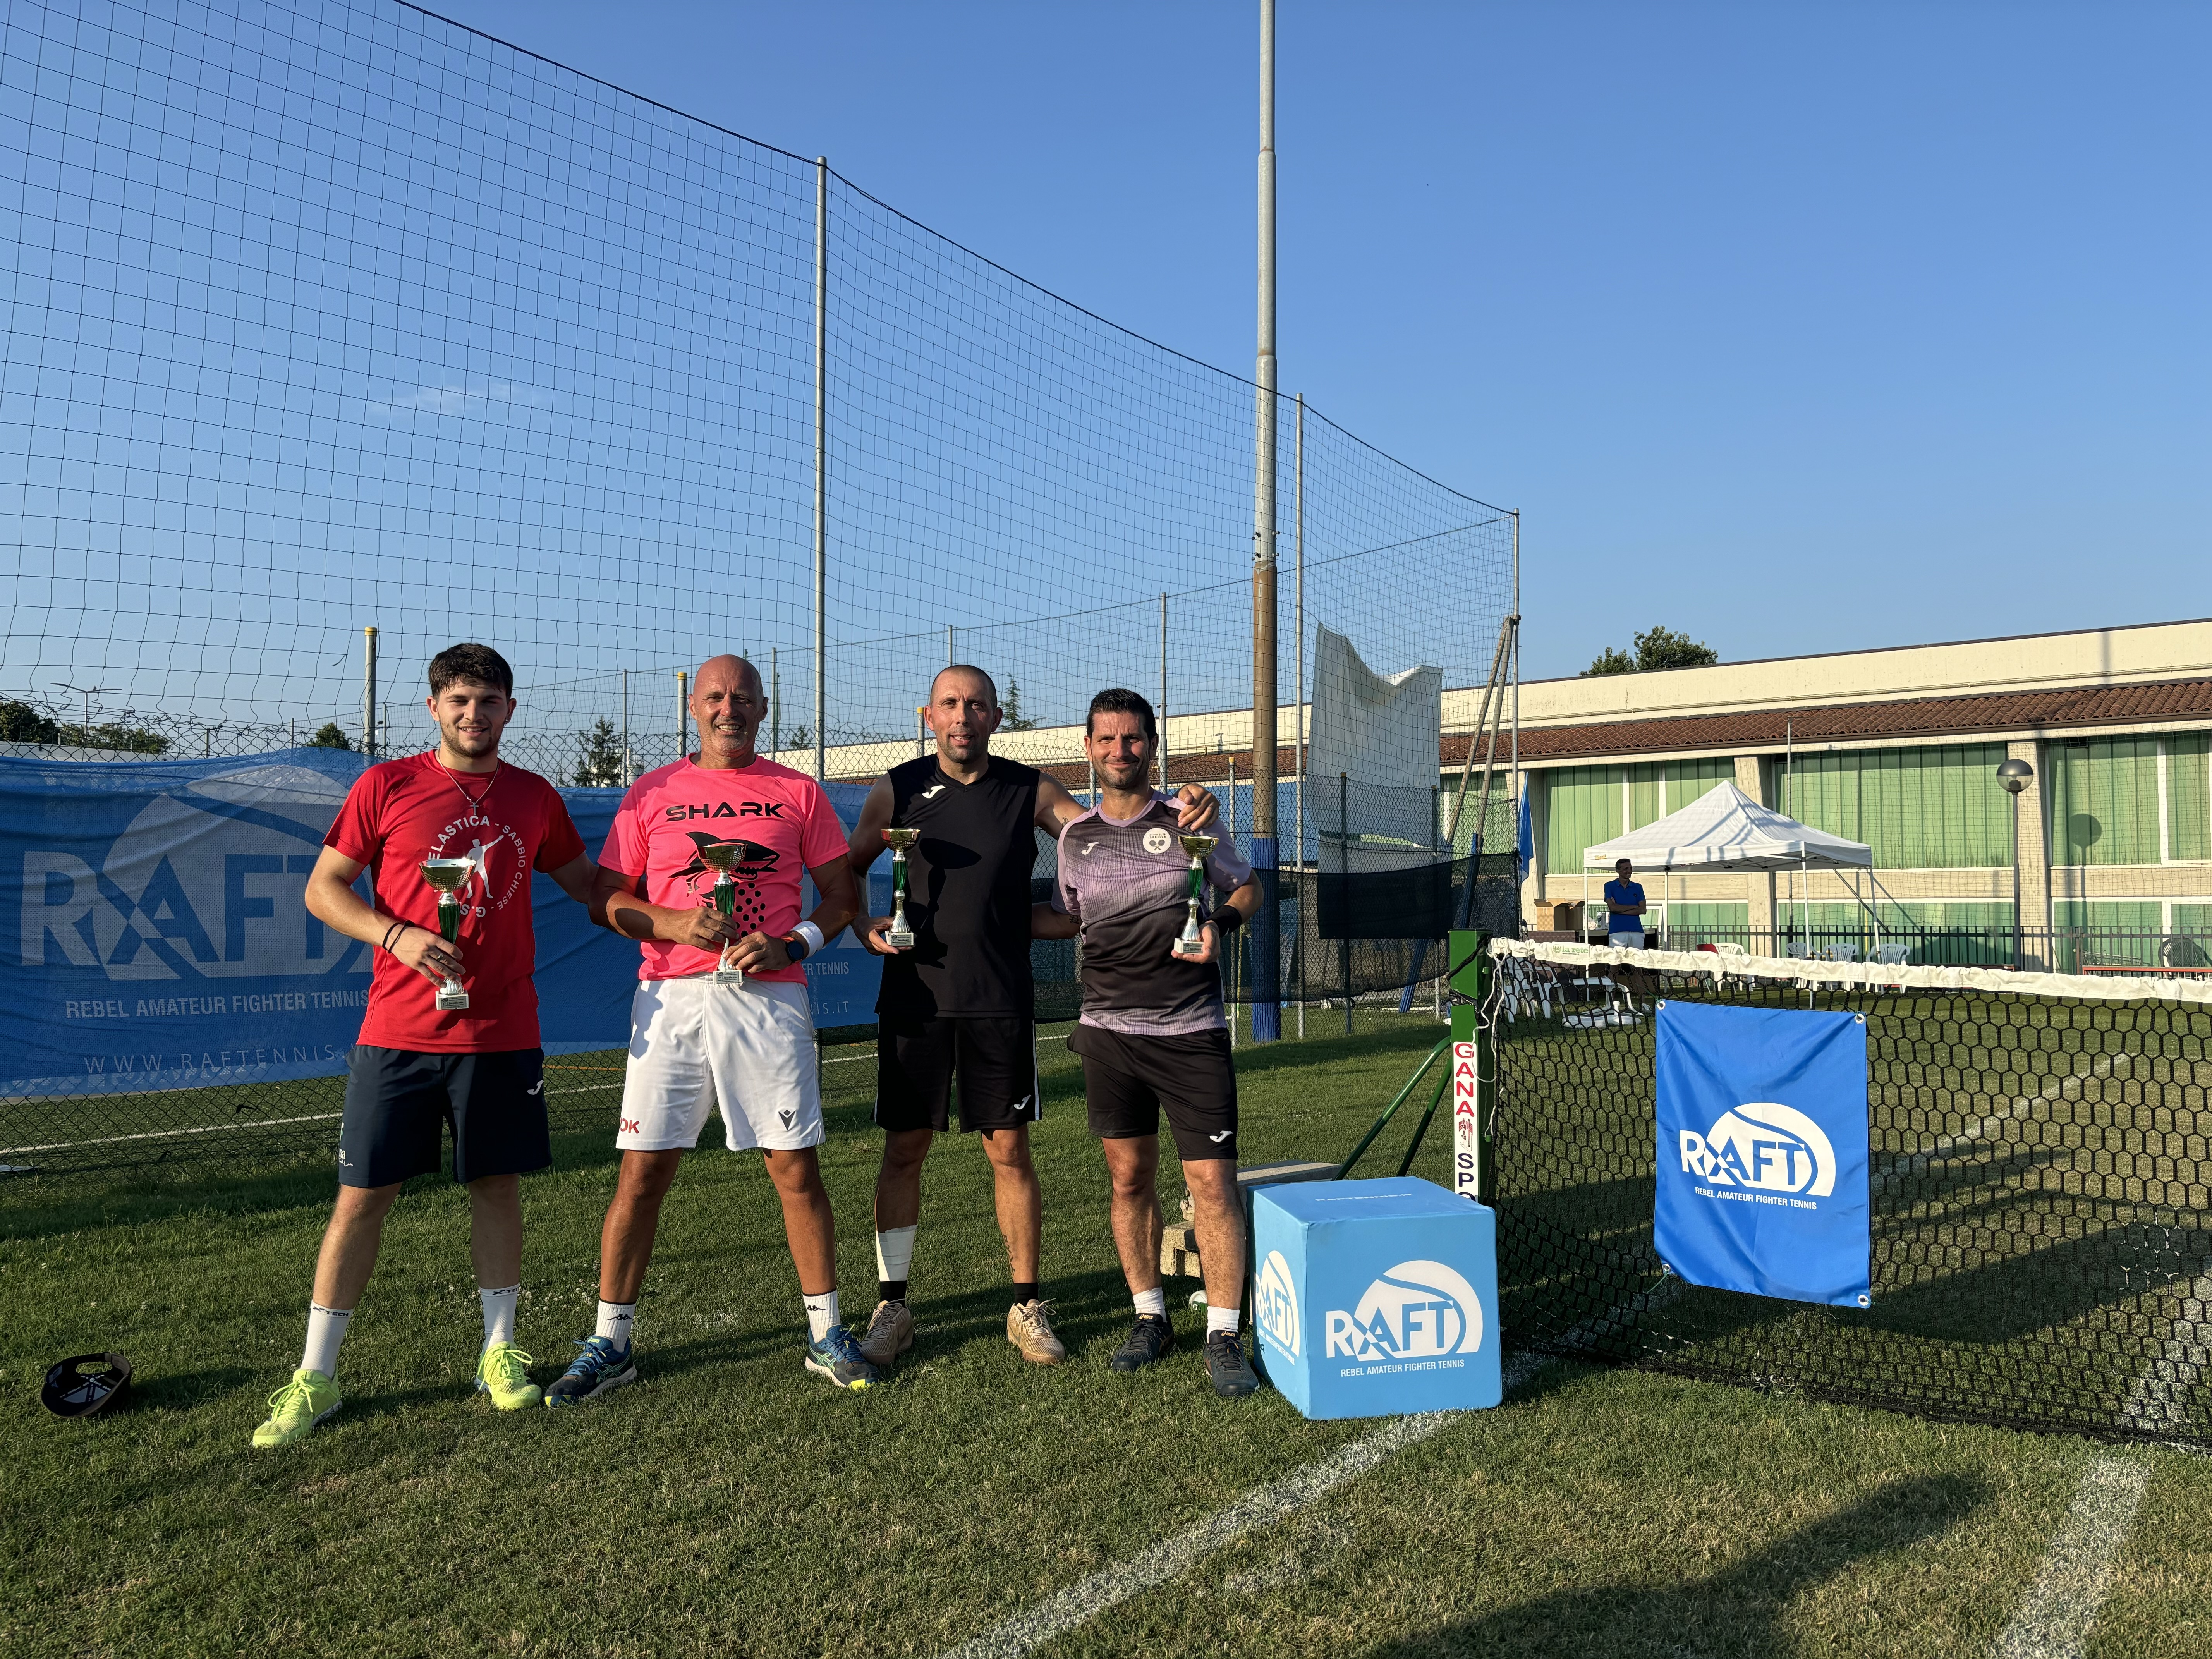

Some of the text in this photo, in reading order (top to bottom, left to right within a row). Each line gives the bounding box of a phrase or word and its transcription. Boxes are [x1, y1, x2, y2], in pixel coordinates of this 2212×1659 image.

[665, 802, 785, 822] SHARK
[502, 825, 526, 867] SABBIO
[21, 851, 326, 967] RAFT
[497, 872, 522, 910] CHIESE
[816, 961, 849, 975] TENNIS
[66, 989, 369, 1019] REBEL AMATEUR FIGHTER TENNIS
[84, 1043, 356, 1074] WWW.RAFTENNIS.
[1455, 1043, 1475, 1117] GANA
[1679, 1130, 1805, 1186] RAFT
[1695, 1187, 1817, 1210] REBEL AMATEUR FIGHTER TENNIS
[1254, 1271, 1291, 1341] RAFT
[1326, 1300, 1453, 1358] RAFT
[1341, 1359, 1465, 1377] REBEL AMATEUR FIGHTER TENNIS
